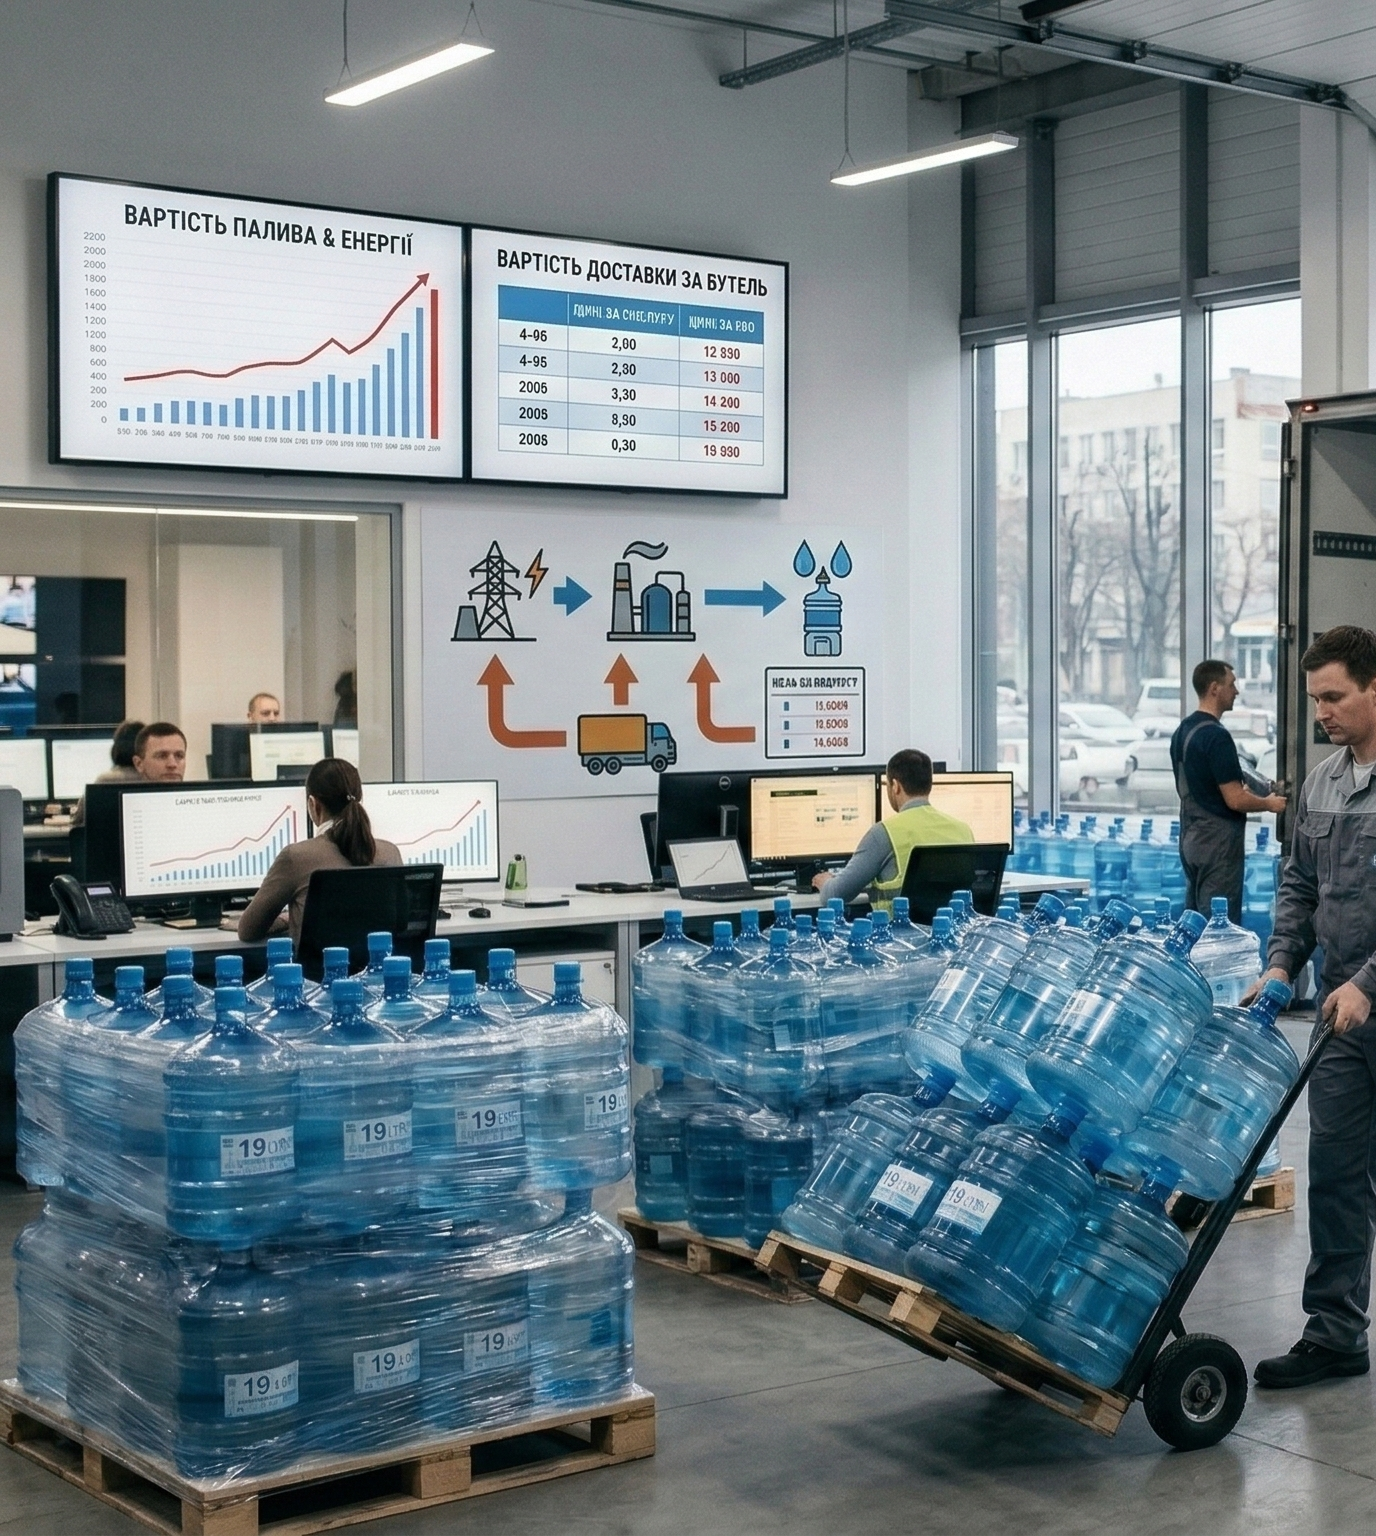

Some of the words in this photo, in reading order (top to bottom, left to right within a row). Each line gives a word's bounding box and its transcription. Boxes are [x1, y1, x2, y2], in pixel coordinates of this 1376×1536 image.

[125, 204, 227, 234] ВАРТІСТЬ
[234, 217, 317, 245] ПАЛИВА
[323, 228, 335, 247] &
[342, 230, 413, 255] ЕНЕРГІЇ
[84, 232, 105, 241] 2200
[84, 246, 106, 255] 2000
[498, 249, 581, 275] ВАРТІСТЬ
[587, 260, 676, 286] ДОСТАВКИ
[682, 271, 702, 289] ЗА
[708, 274, 767, 296] БУТЕЛЬ
[85, 274, 106, 283] 1800
[85, 288, 106, 297] 1600
[85, 303, 106, 311] 1400
[85, 316, 106, 325] 1200
[85, 330, 106, 339] 1200
[90, 344, 106, 353] 800
[704, 346, 716, 358] 12
[90, 359, 106, 367] 600
[90, 373, 106, 381] 400
[704, 371, 716, 382] 13
[90, 386, 107, 394] 200
[612, 388, 636, 402] 3,30
[90, 400, 107, 408] 200
[704, 396, 716, 406] 14
[704, 420, 716, 431] 15
[612, 439, 636, 452] 0,30
[599, 1094, 617, 1112] 19
[472, 1110, 496, 1129] 19
[361, 1122, 386, 1142] 19
[239, 1138, 266, 1157] 19
[481, 1333, 504, 1352] 19
[372, 1353, 395, 1372] 19
[244, 1376, 270, 1396] 19
